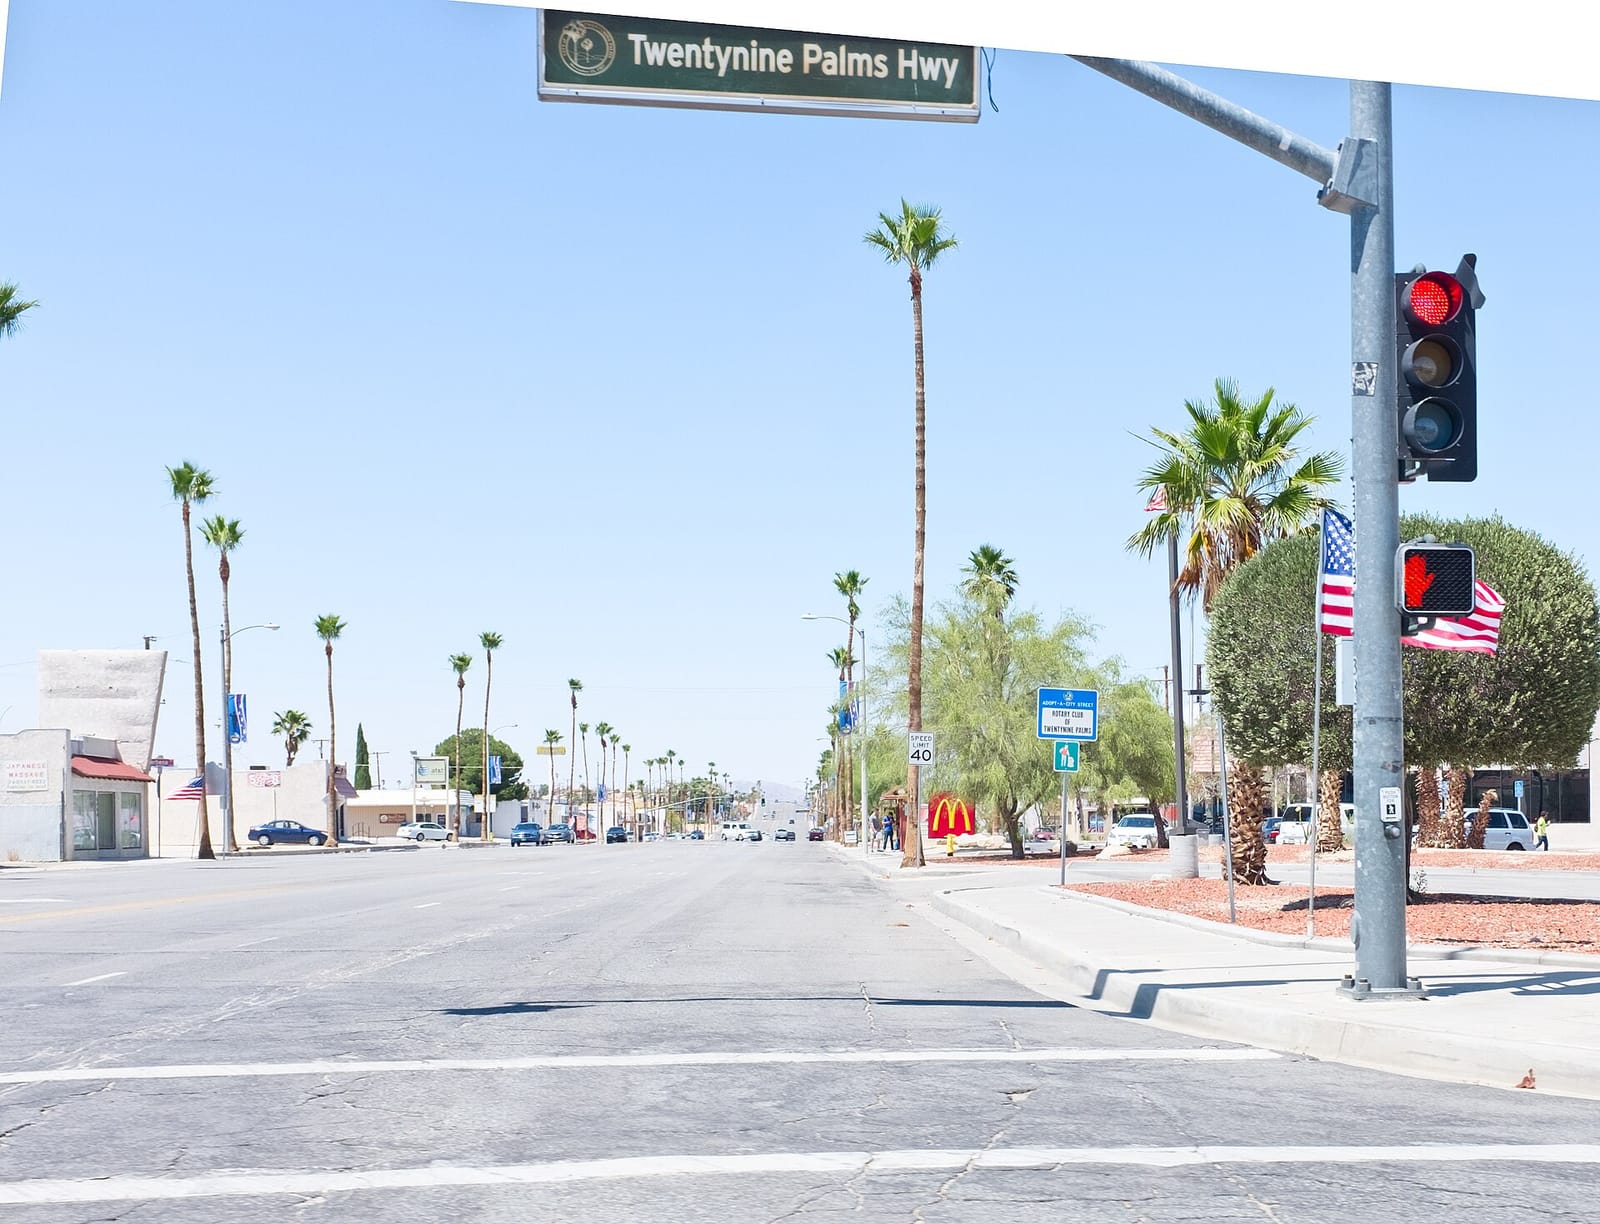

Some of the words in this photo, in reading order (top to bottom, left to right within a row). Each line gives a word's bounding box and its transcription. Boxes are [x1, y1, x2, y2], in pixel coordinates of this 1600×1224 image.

[627, 33, 794, 77] Twentynine
[802, 43, 889, 79] Palms
[898, 48, 959, 89] Hwy
[1052, 710, 1070, 718] ROTARY
[1071, 711, 1084, 719] CLUB
[1043, 725, 1074, 734] TWENTYNINE
[1075, 727, 1092, 735] PALMS
[910, 749, 932, 762] 40
